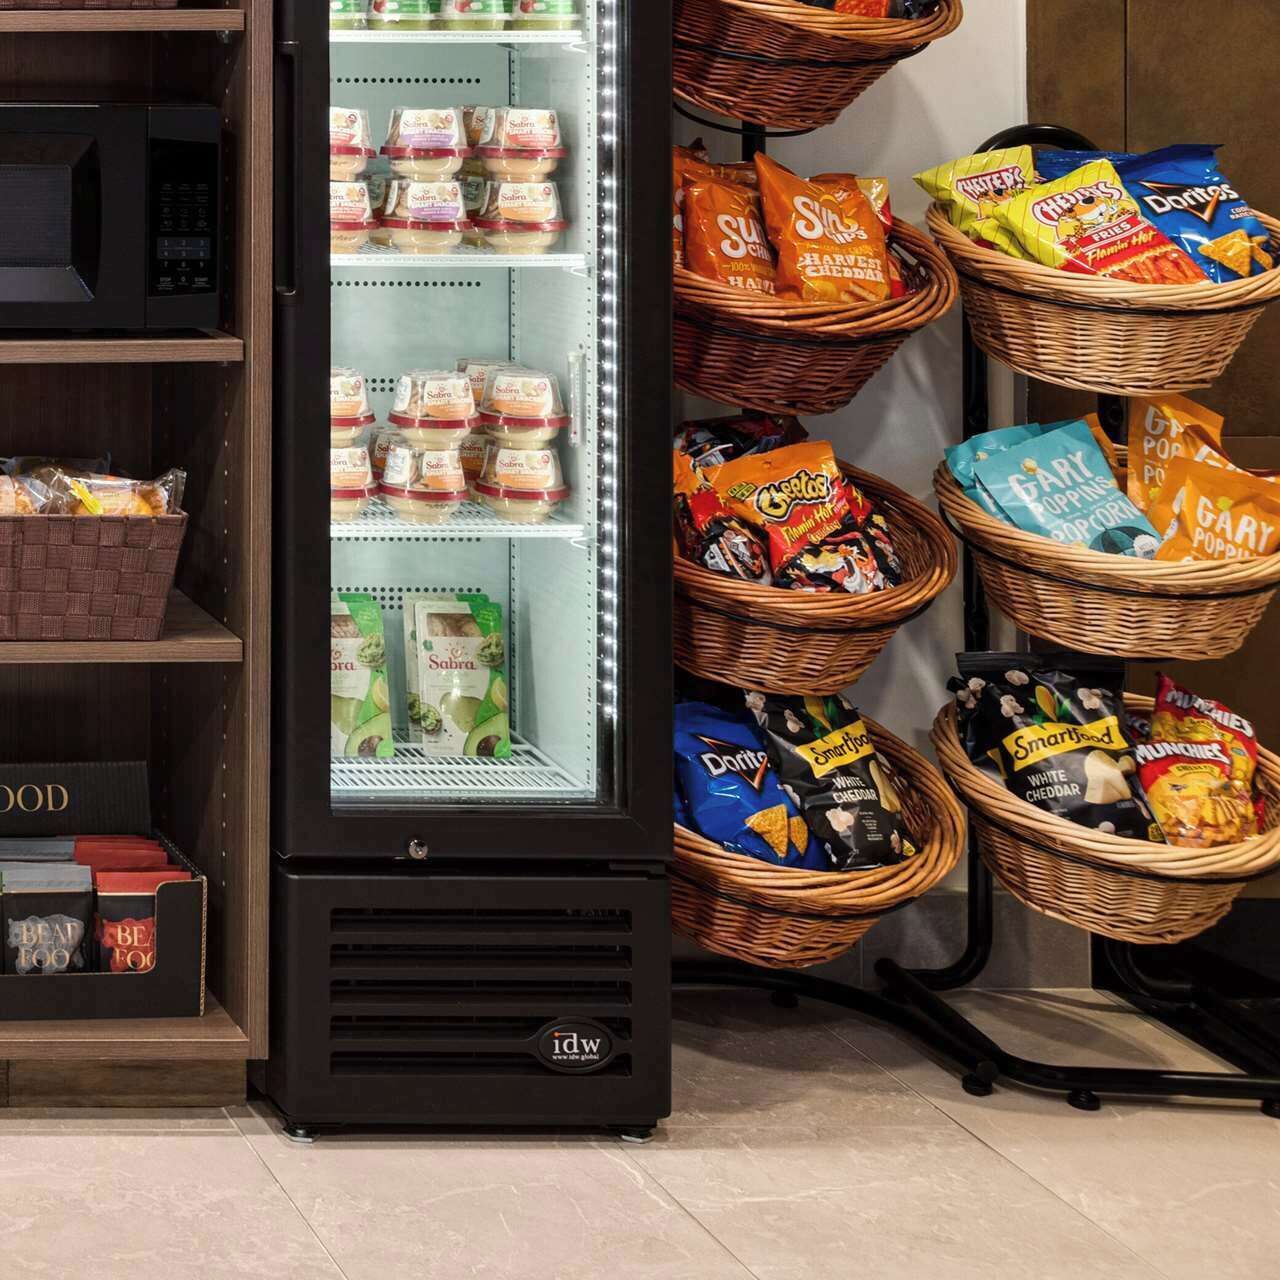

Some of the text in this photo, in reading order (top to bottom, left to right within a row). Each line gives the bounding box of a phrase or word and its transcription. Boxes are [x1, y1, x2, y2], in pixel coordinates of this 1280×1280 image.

[403, 120, 428, 130] Sabra
[509, 120, 535, 130] Sabra
[956, 165, 1026, 200] CHESTER'S
[411, 192, 436, 202] Sabra
[501, 192, 527, 202] Sabra
[1034, 181, 1122, 224] CHESTER'S
[1142, 183, 1240, 213] Doritos
[1092, 221, 1133, 244] FRIES
[1087, 230, 1157, 262] Flamin' Hot
[801, 252, 882, 271] HARVEST
[805, 264, 885, 283] CHEDDAR
[426, 389, 452, 401] Sabra
[495, 385, 520, 396] Sabra
[498, 459, 525, 470] Sabra
[1007, 451, 1094, 504] GARY
[756, 469, 832, 519] Cheetos
[1028, 474, 1113, 524] POPPINS
[782, 515, 816, 544] Flamin'
[815, 502, 834, 524] Hot
[1049, 502, 1143, 543] POPCORN
[1196, 495, 1275, 553] GARY
[428, 653, 477, 671] Sabra
[1165, 688, 1254, 738] MUNCHIES
[1013, 720, 1114, 761] Smartfood
[1135, 743, 1232, 766] MUNCHIES
[832, 776, 866, 790] WHITE
[1027, 770, 1069, 788] WHITE
[832, 788, 878, 804] CHEDDAR
[1025, 783, 1082, 804] CHEDDAR
[552, 1032, 601, 1054] idw
